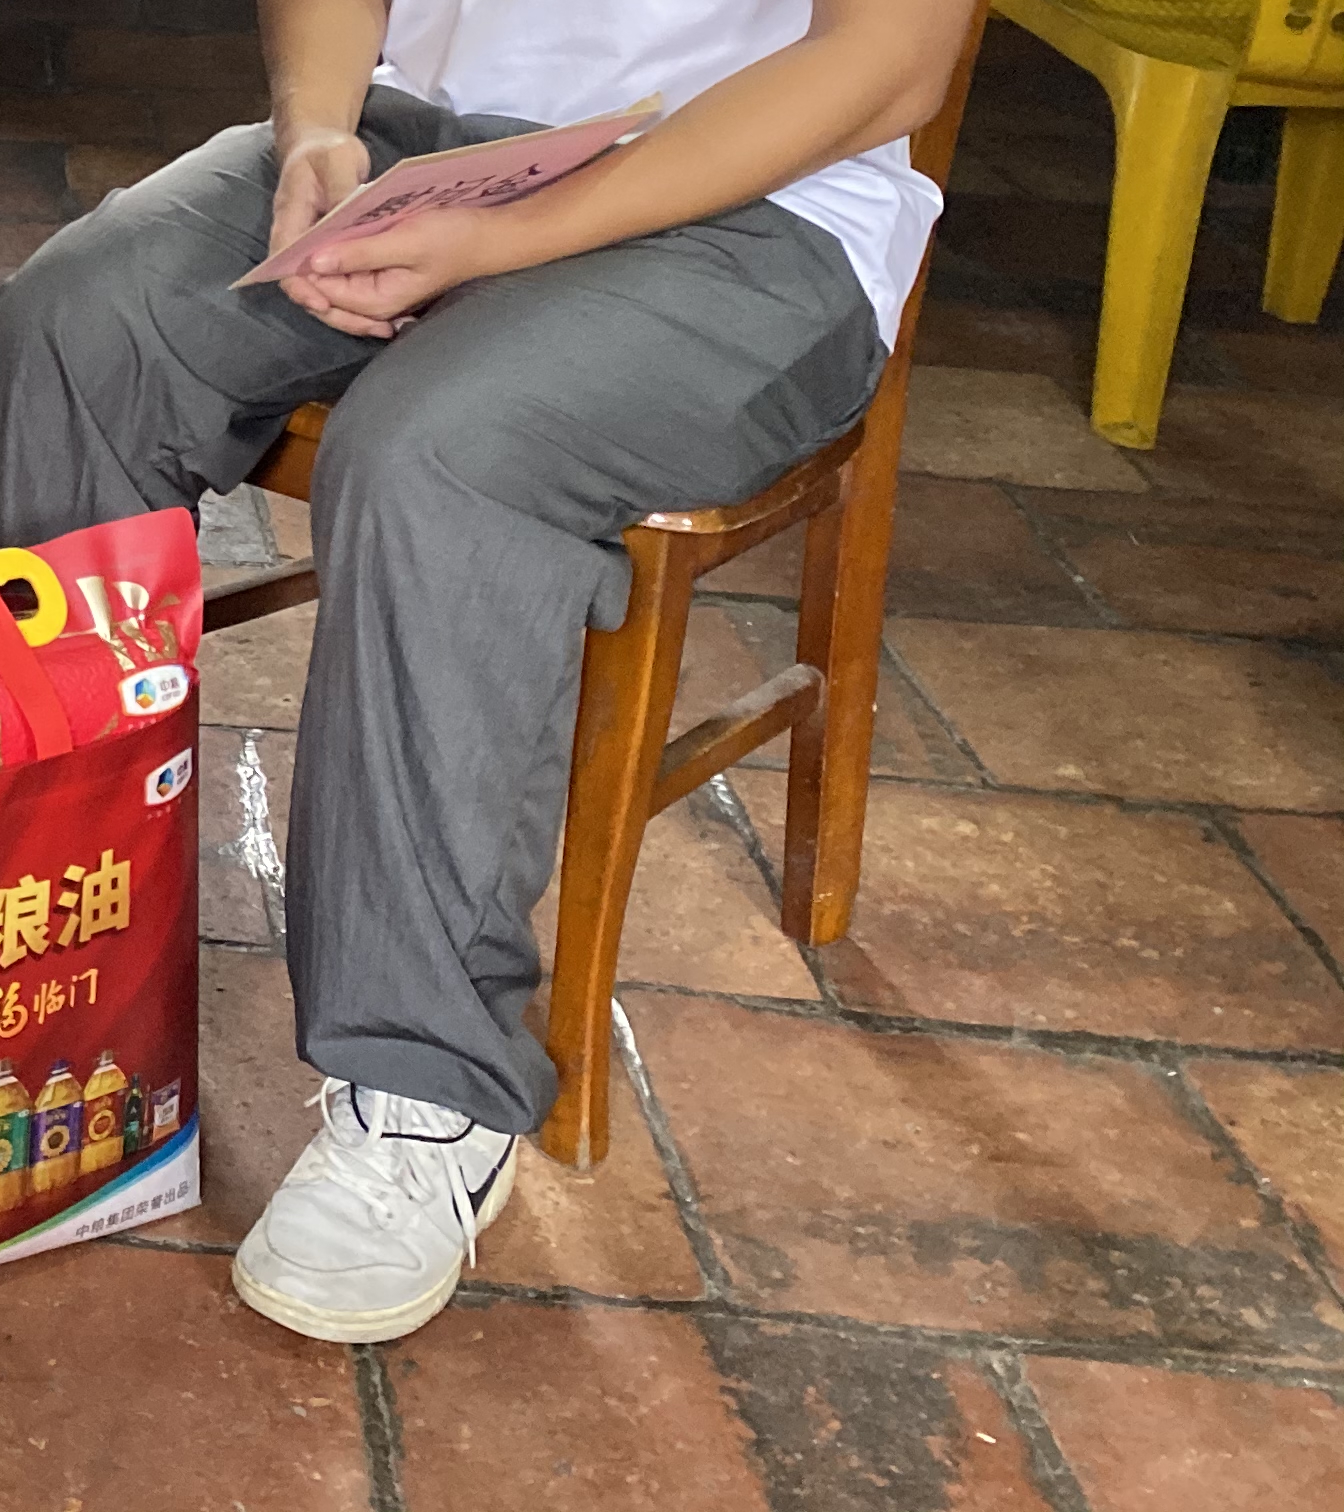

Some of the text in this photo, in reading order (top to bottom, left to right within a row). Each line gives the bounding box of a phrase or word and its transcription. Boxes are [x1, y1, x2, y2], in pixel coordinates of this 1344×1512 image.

[75, 1180, 190, 1239] 中粮集团荣誉出品
